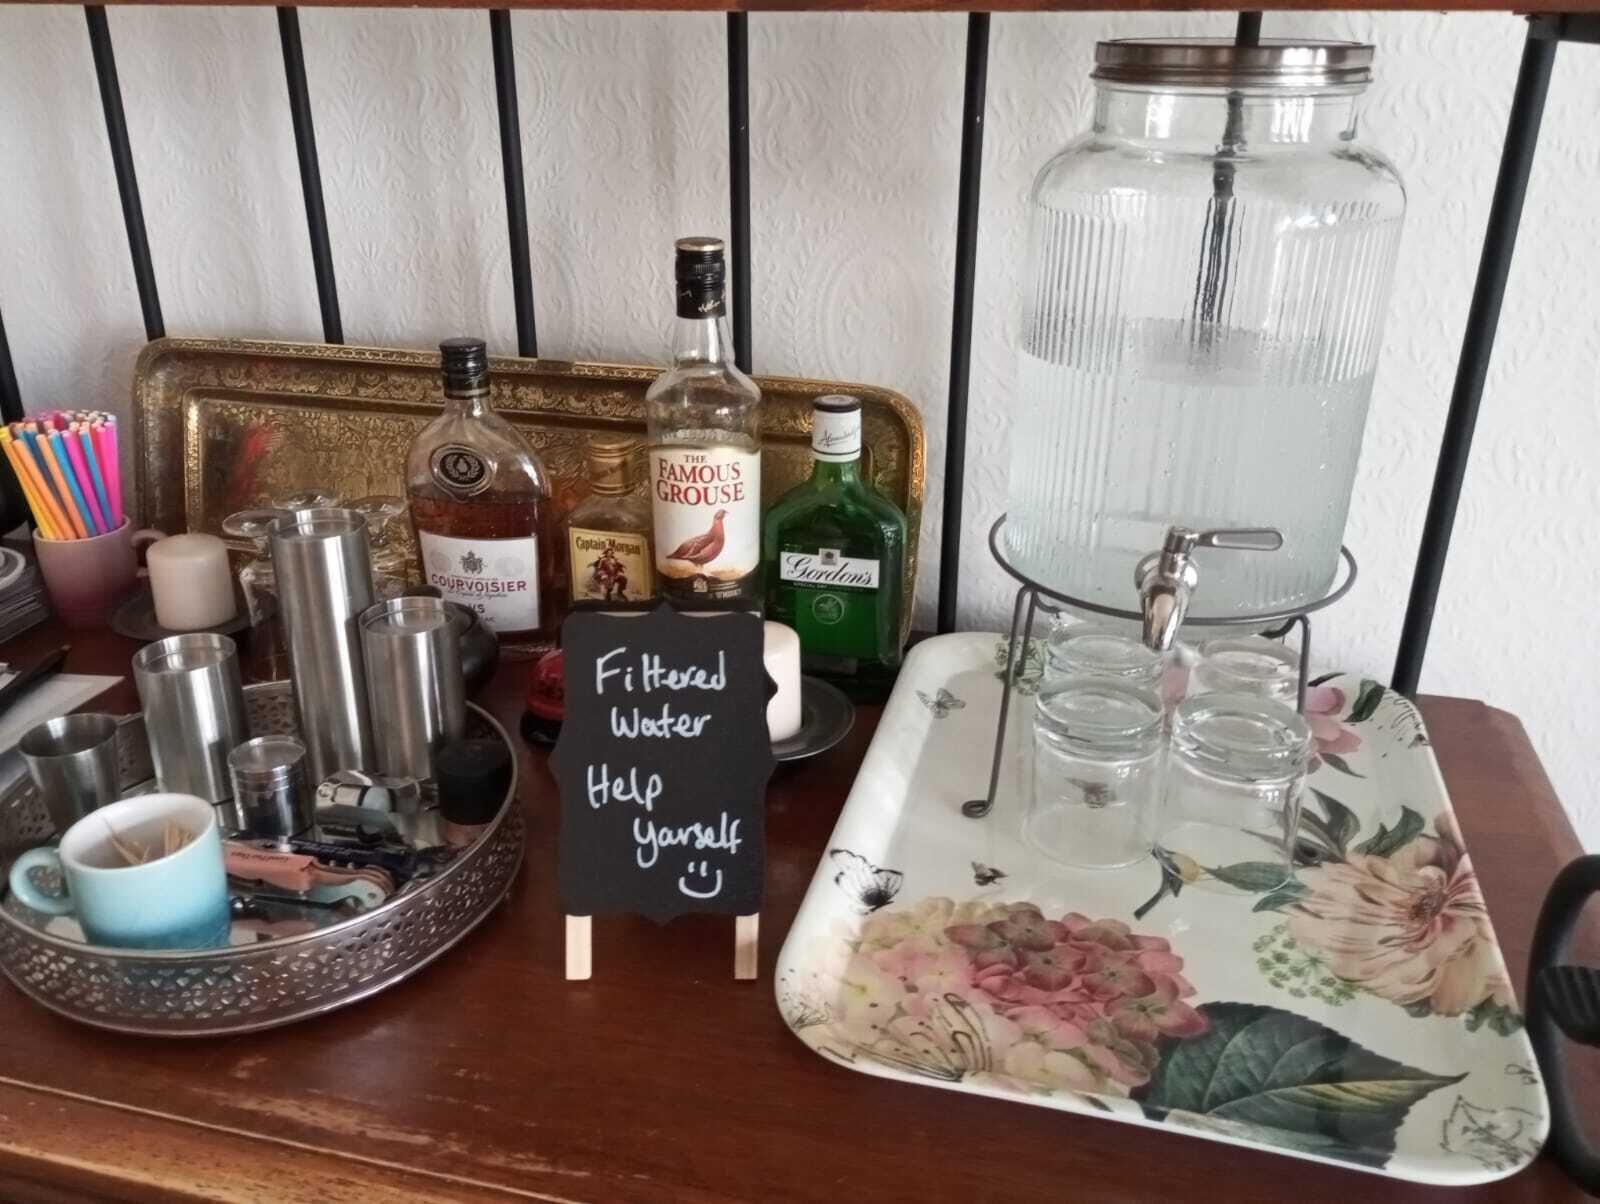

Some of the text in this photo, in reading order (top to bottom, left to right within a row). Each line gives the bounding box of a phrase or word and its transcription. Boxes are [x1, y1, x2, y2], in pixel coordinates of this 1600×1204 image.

[658, 457, 741, 484] FAMOUS
[684, 455, 706, 463] THE
[656, 479, 745, 506] GROUSE
[576, 536, 606, 552] Captain
[431, 573, 527, 593] COURVOISIER
[786, 555, 873, 586] Gordon's
[596, 647, 727, 694] Filtered
[611, 703, 712, 738] Water
[587, 763, 663, 811] Help
